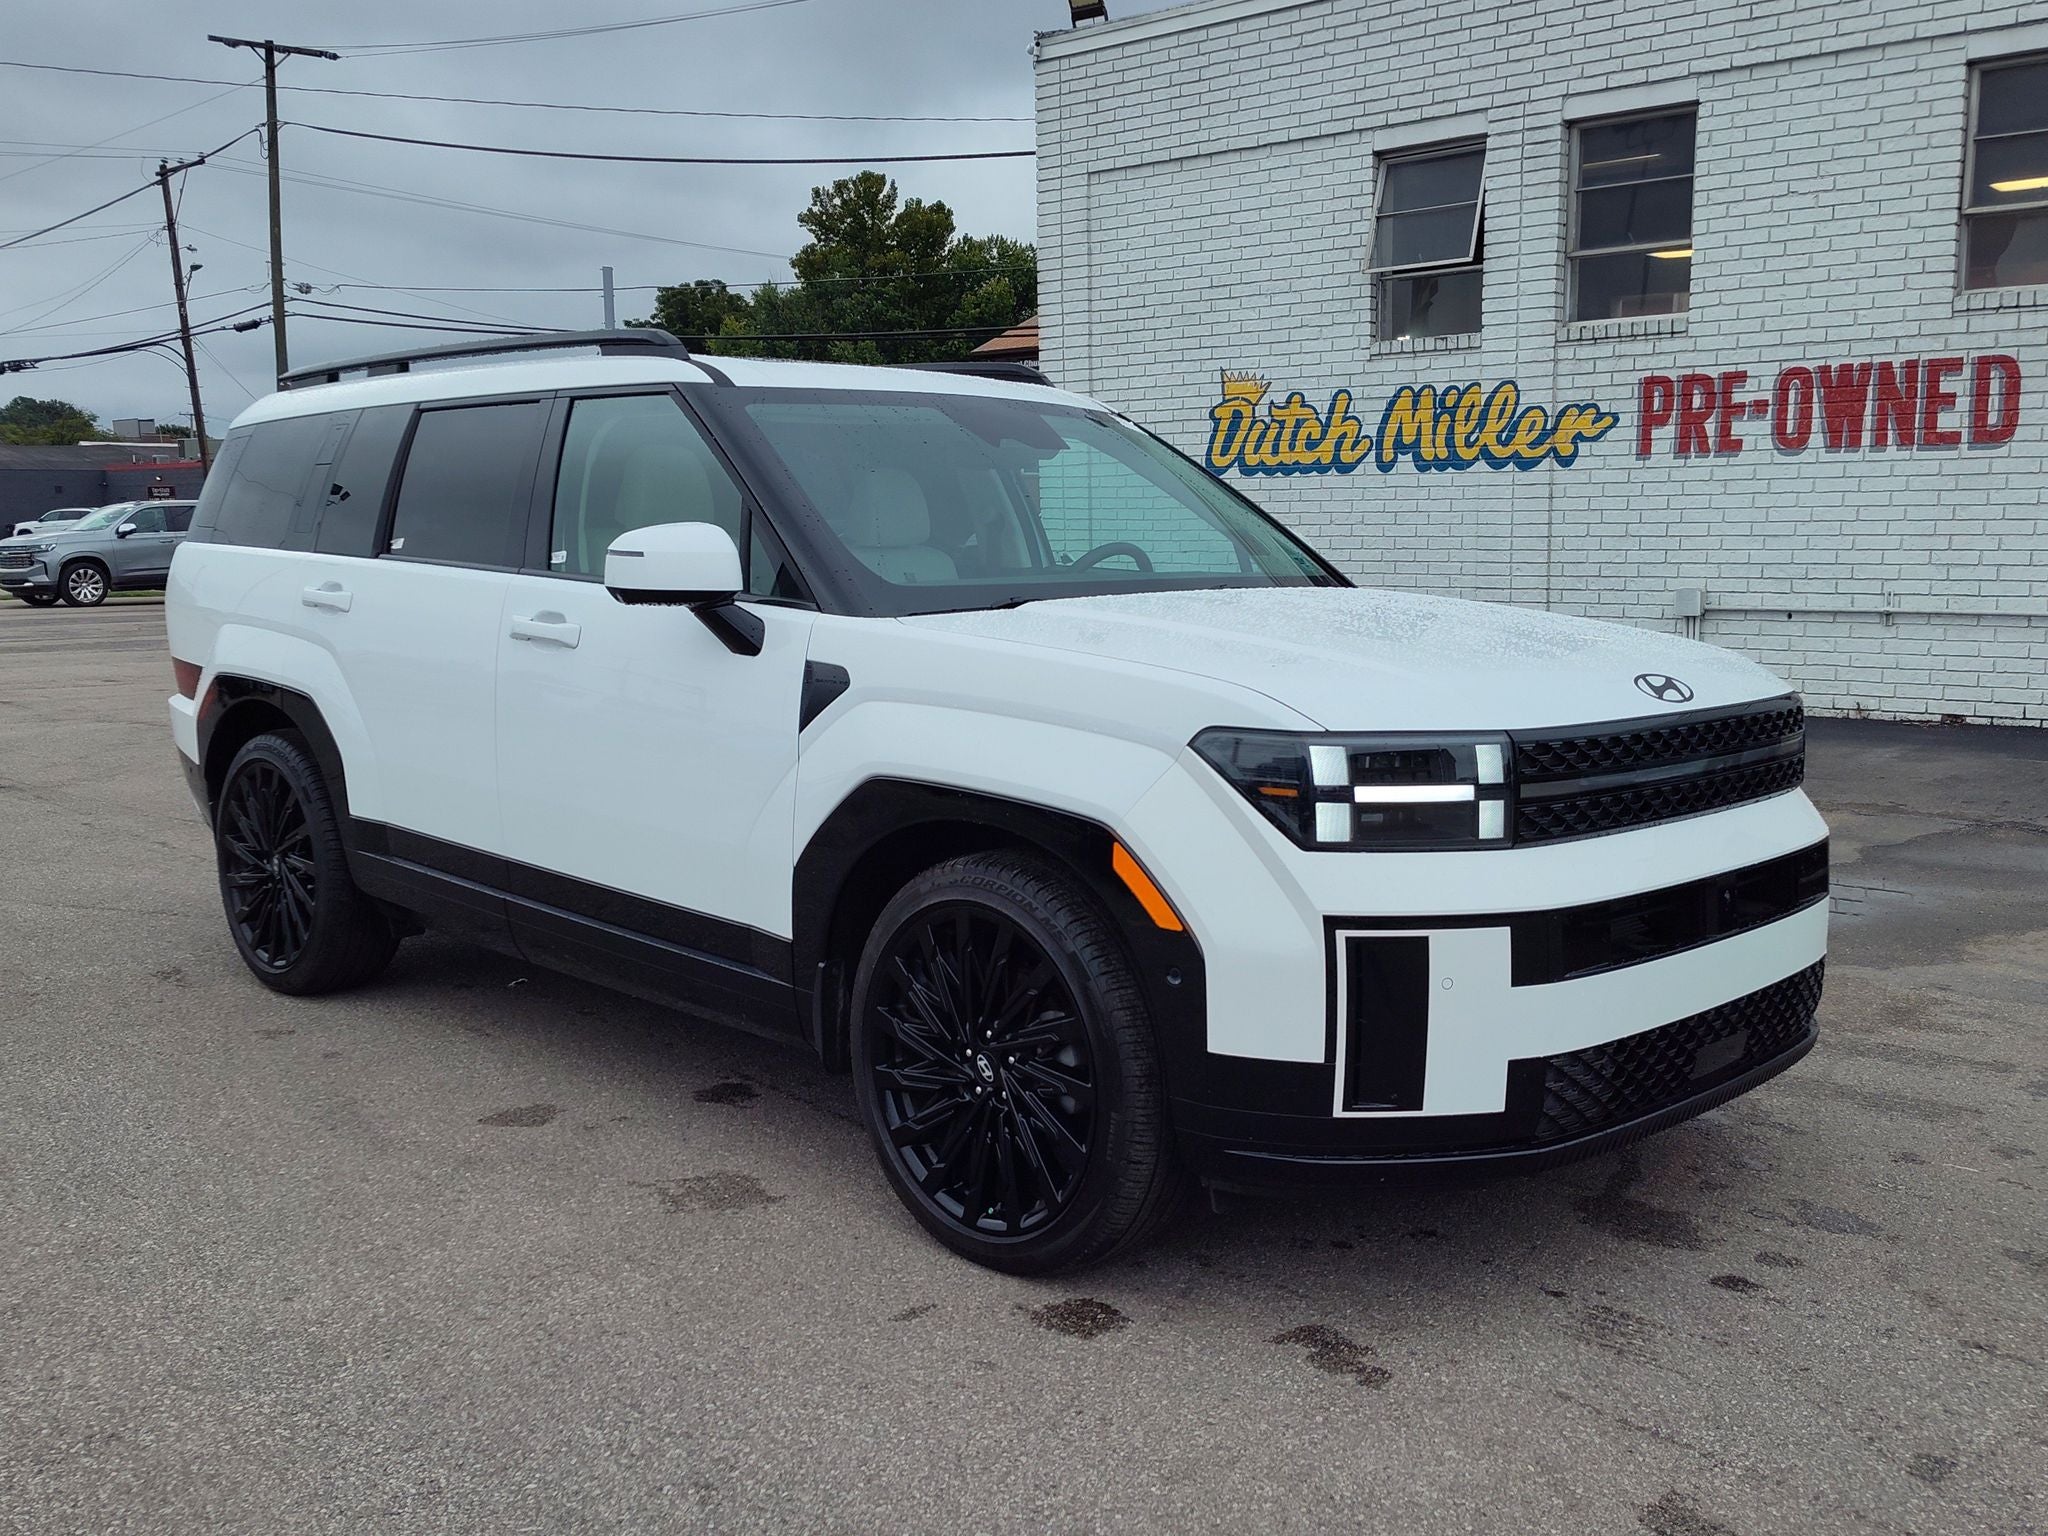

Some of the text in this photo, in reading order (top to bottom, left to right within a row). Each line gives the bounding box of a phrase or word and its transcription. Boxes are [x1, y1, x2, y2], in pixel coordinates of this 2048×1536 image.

[1205, 379, 1620, 477] Dutch Miller
[1636, 354, 2021, 461] PRE-OWNED
